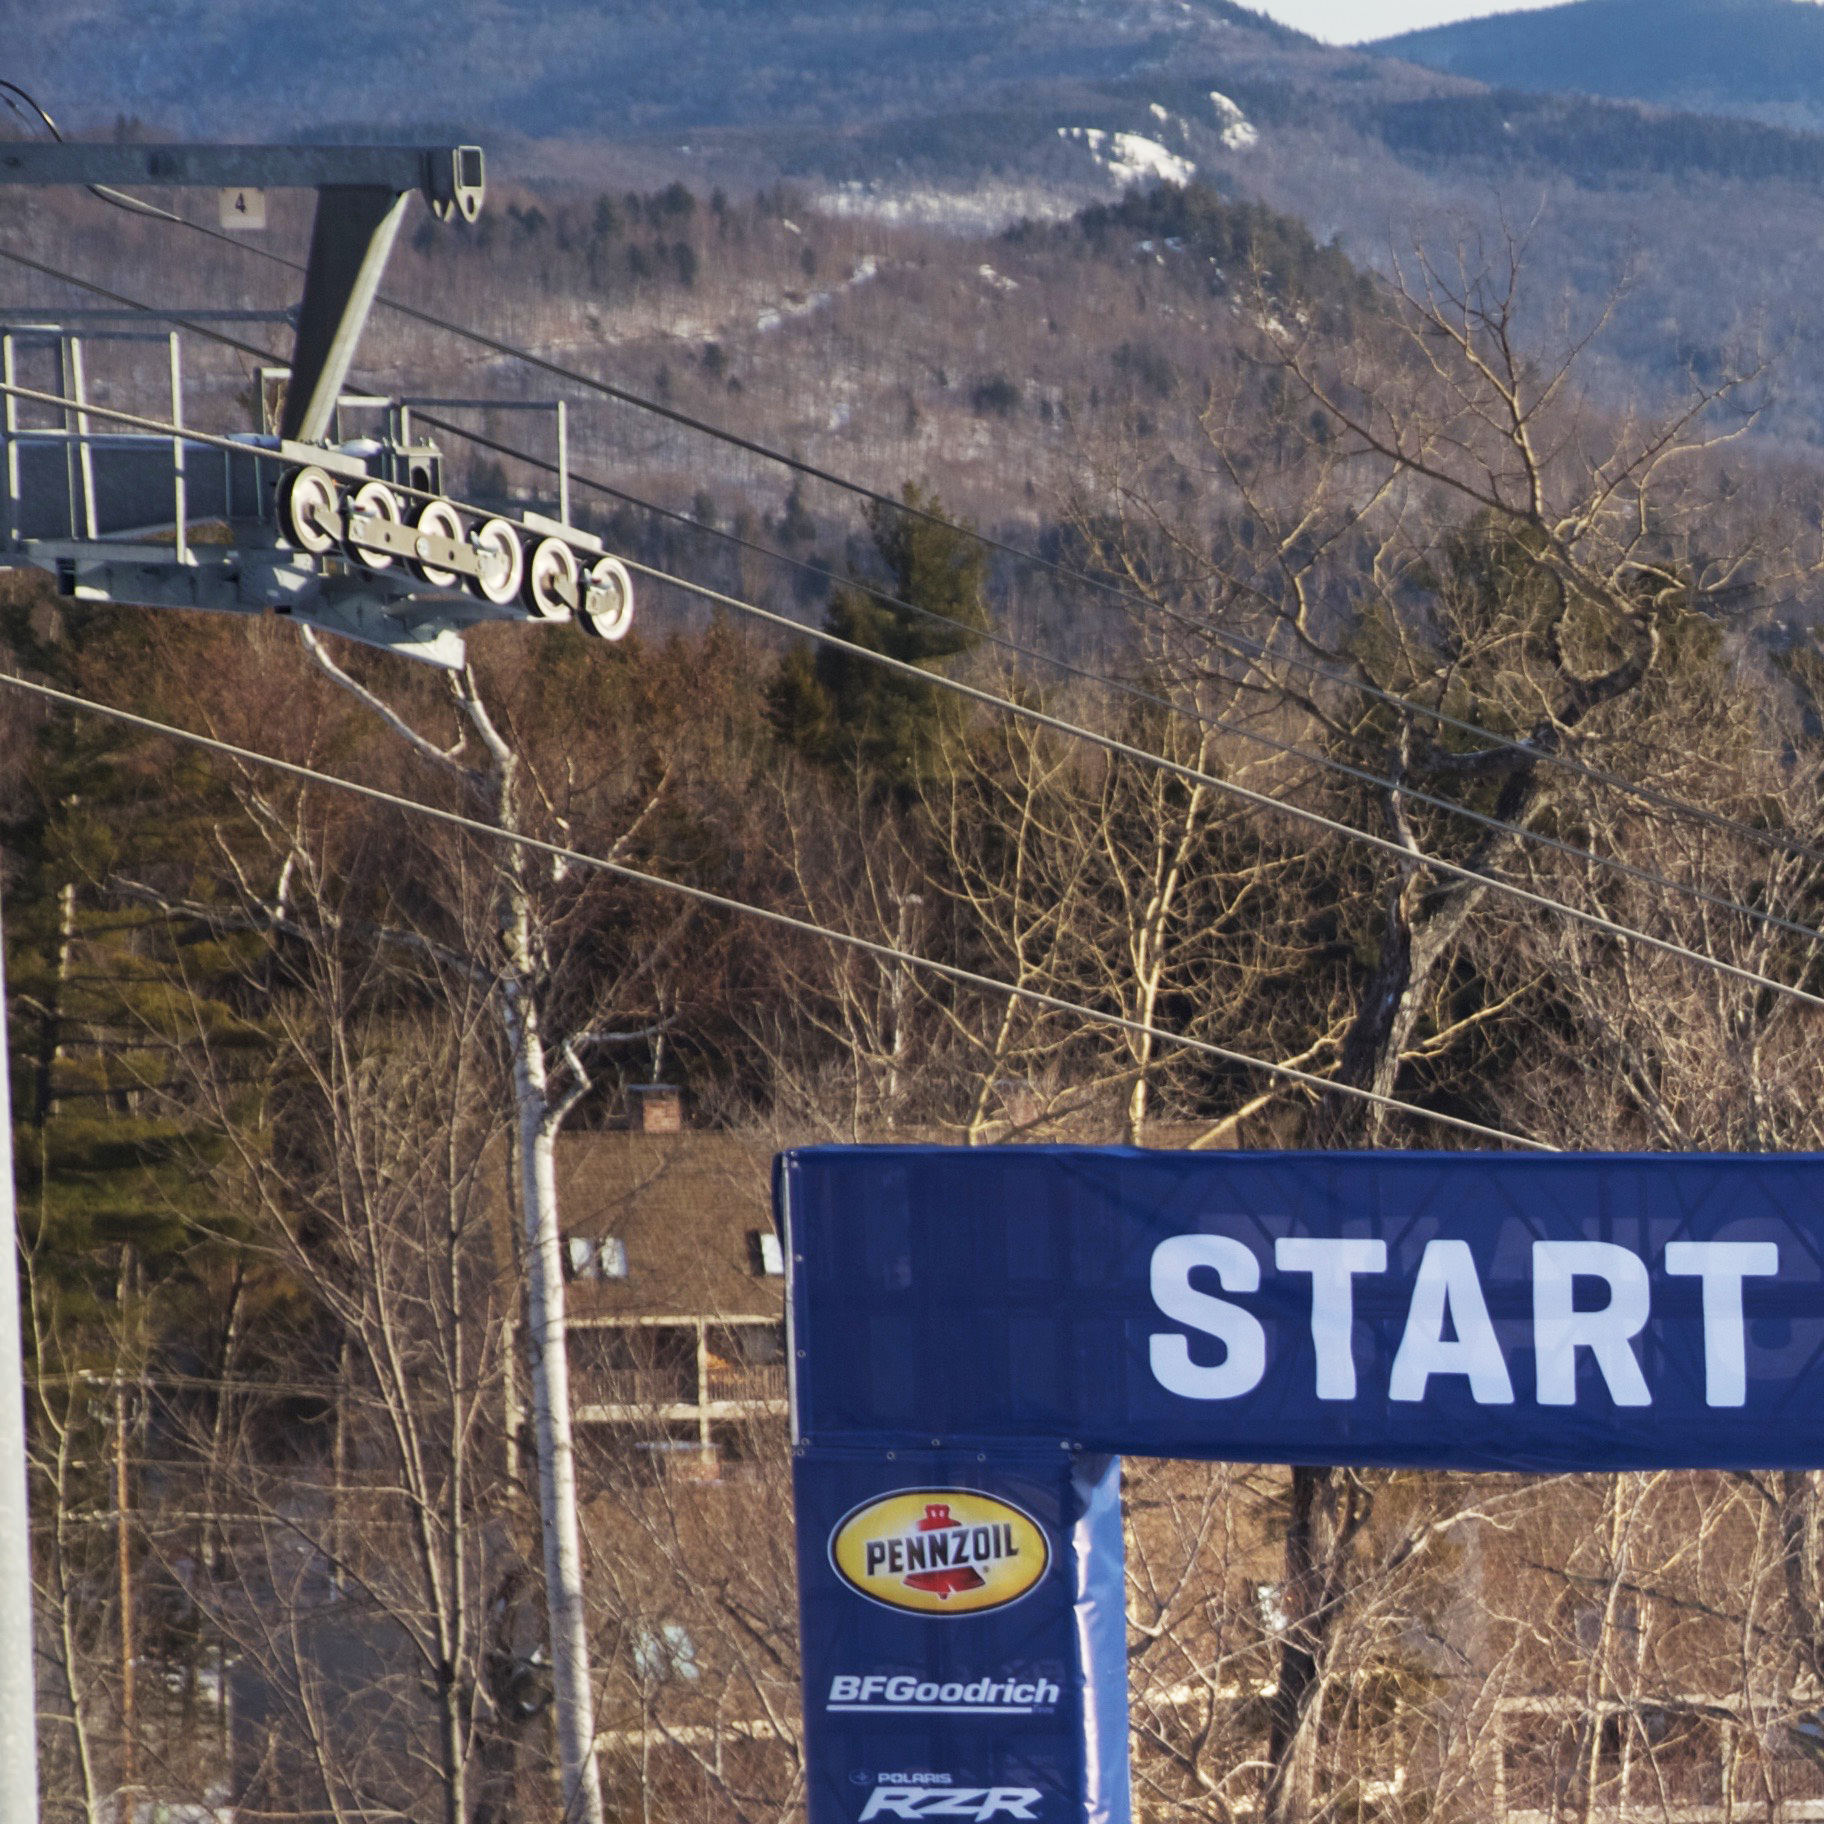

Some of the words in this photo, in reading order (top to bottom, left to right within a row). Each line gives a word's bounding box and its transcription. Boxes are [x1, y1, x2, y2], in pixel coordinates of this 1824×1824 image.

[234, 191, 247, 214] 4
[1149, 1233, 1779, 1407] START
[866, 1522, 1020, 1577] PENNZOIL
[828, 1674, 1059, 1704] BFGoodrich
[877, 1772, 953, 1785] POLARIS
[858, 1786, 1044, 1823] RZR
